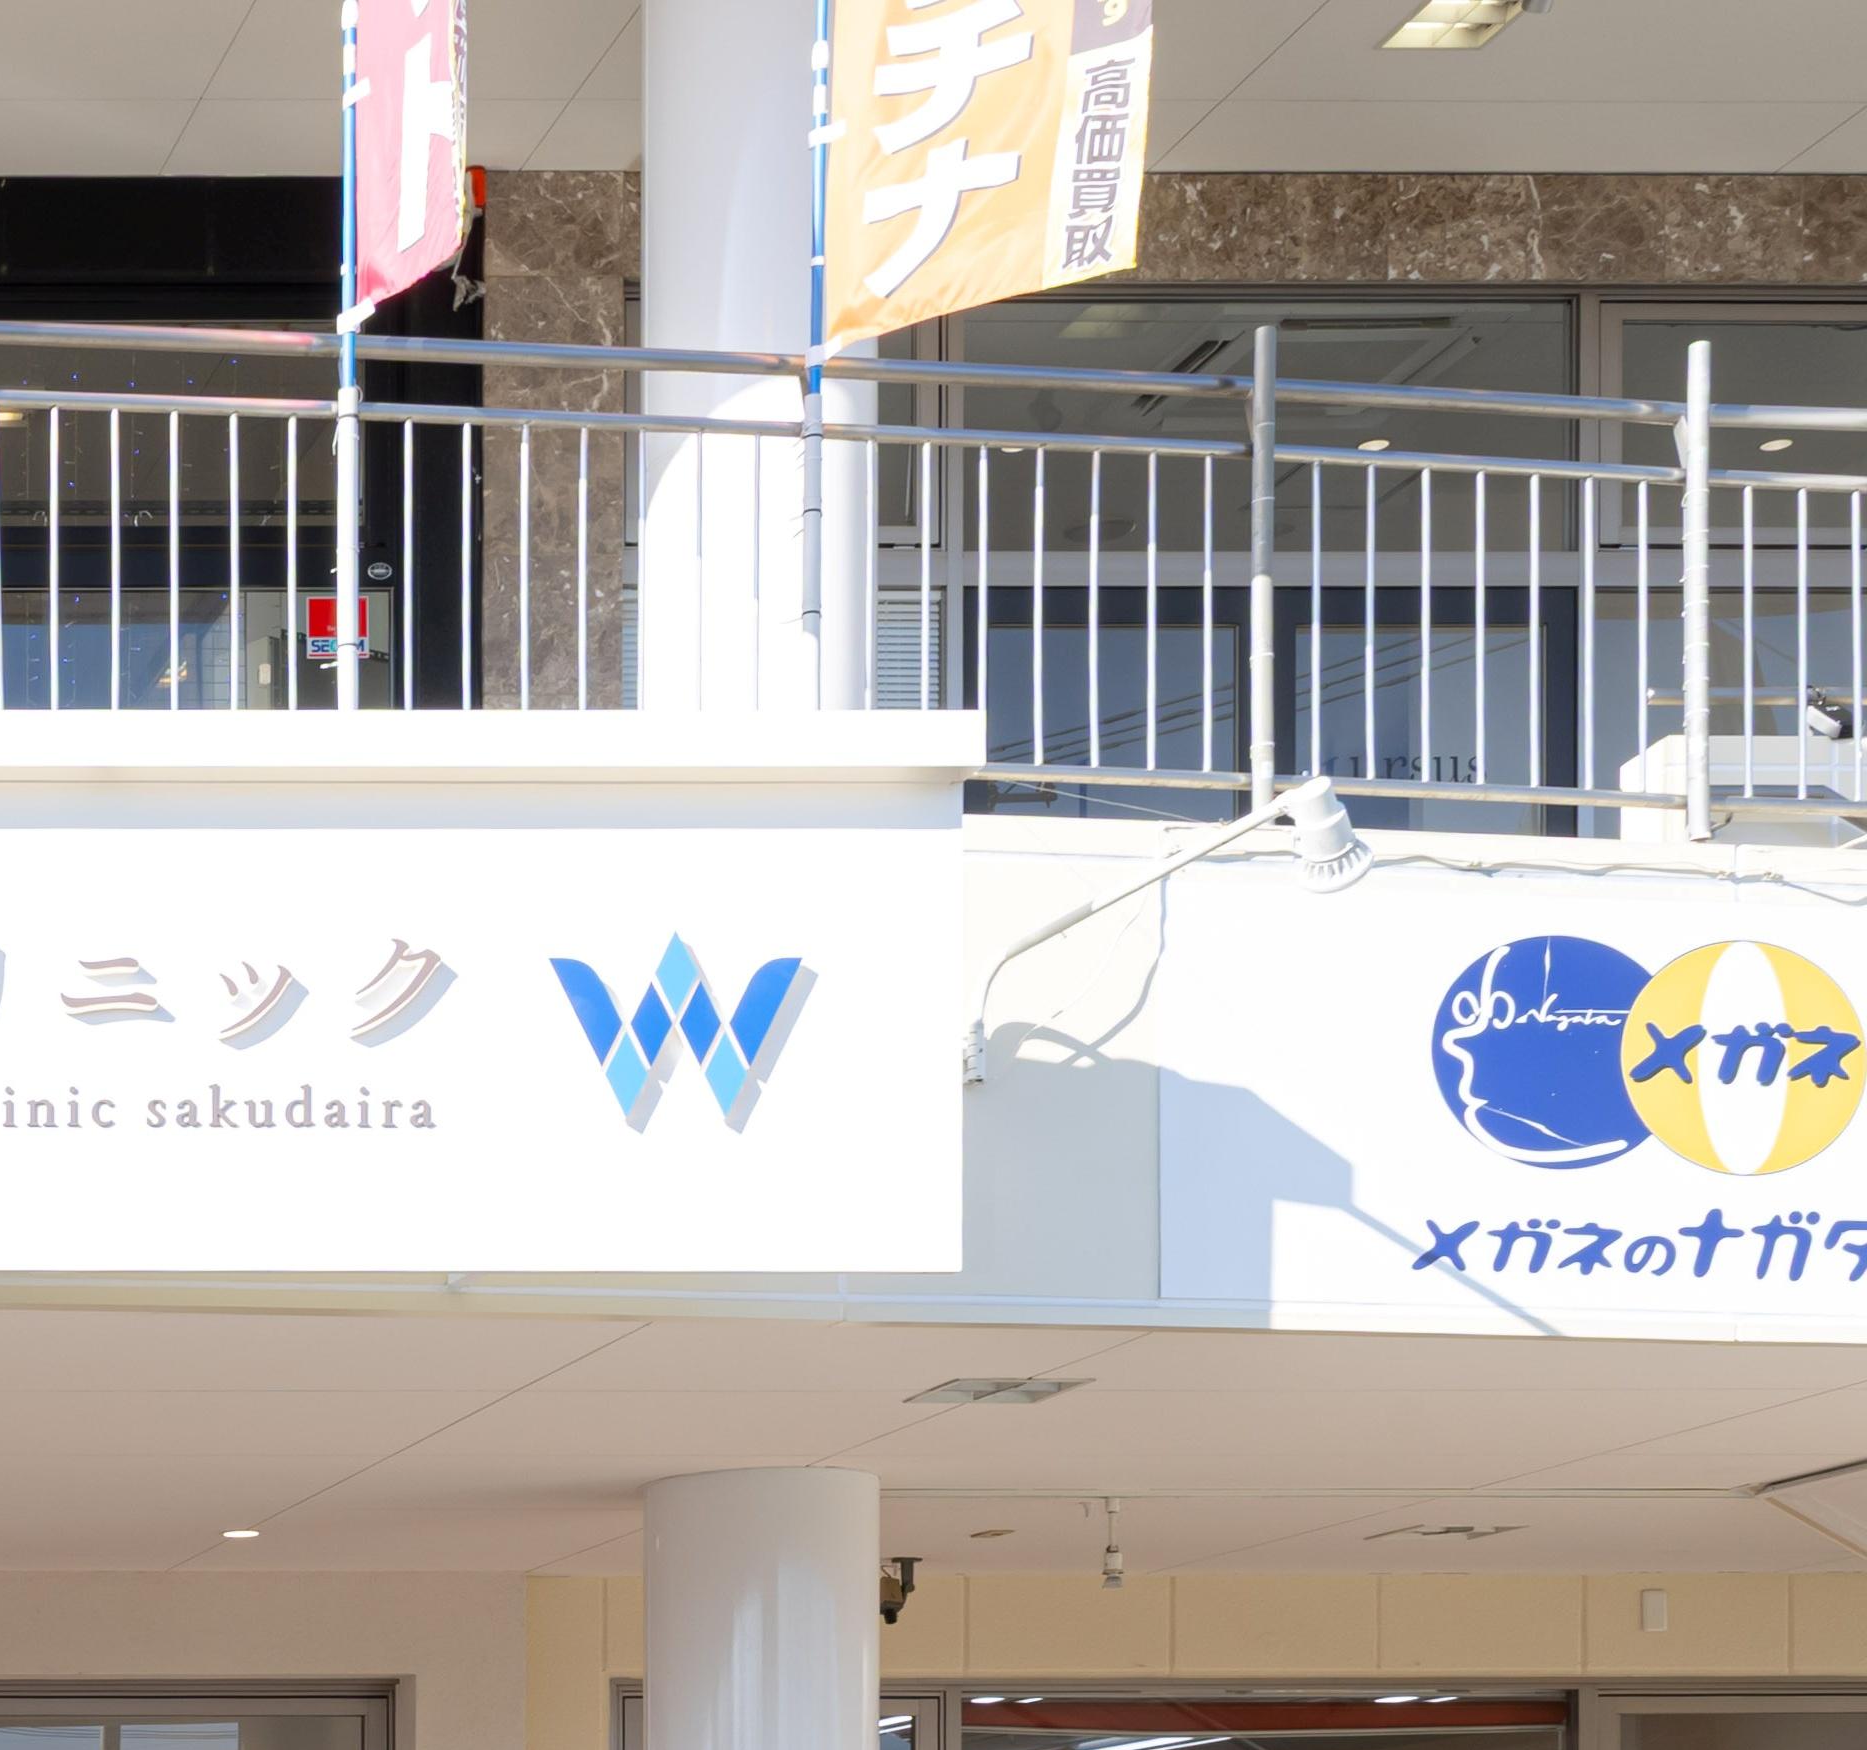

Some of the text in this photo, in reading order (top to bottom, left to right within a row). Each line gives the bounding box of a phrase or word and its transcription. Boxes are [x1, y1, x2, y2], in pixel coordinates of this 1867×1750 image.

[1061, 57, 1136, 270] 高価買取
[1629, 1021, 1862, 1088] メガネ
[145, 1084, 438, 1131] sakudaira
[1412, 1207, 1867, 1283] メガネのナガタ
